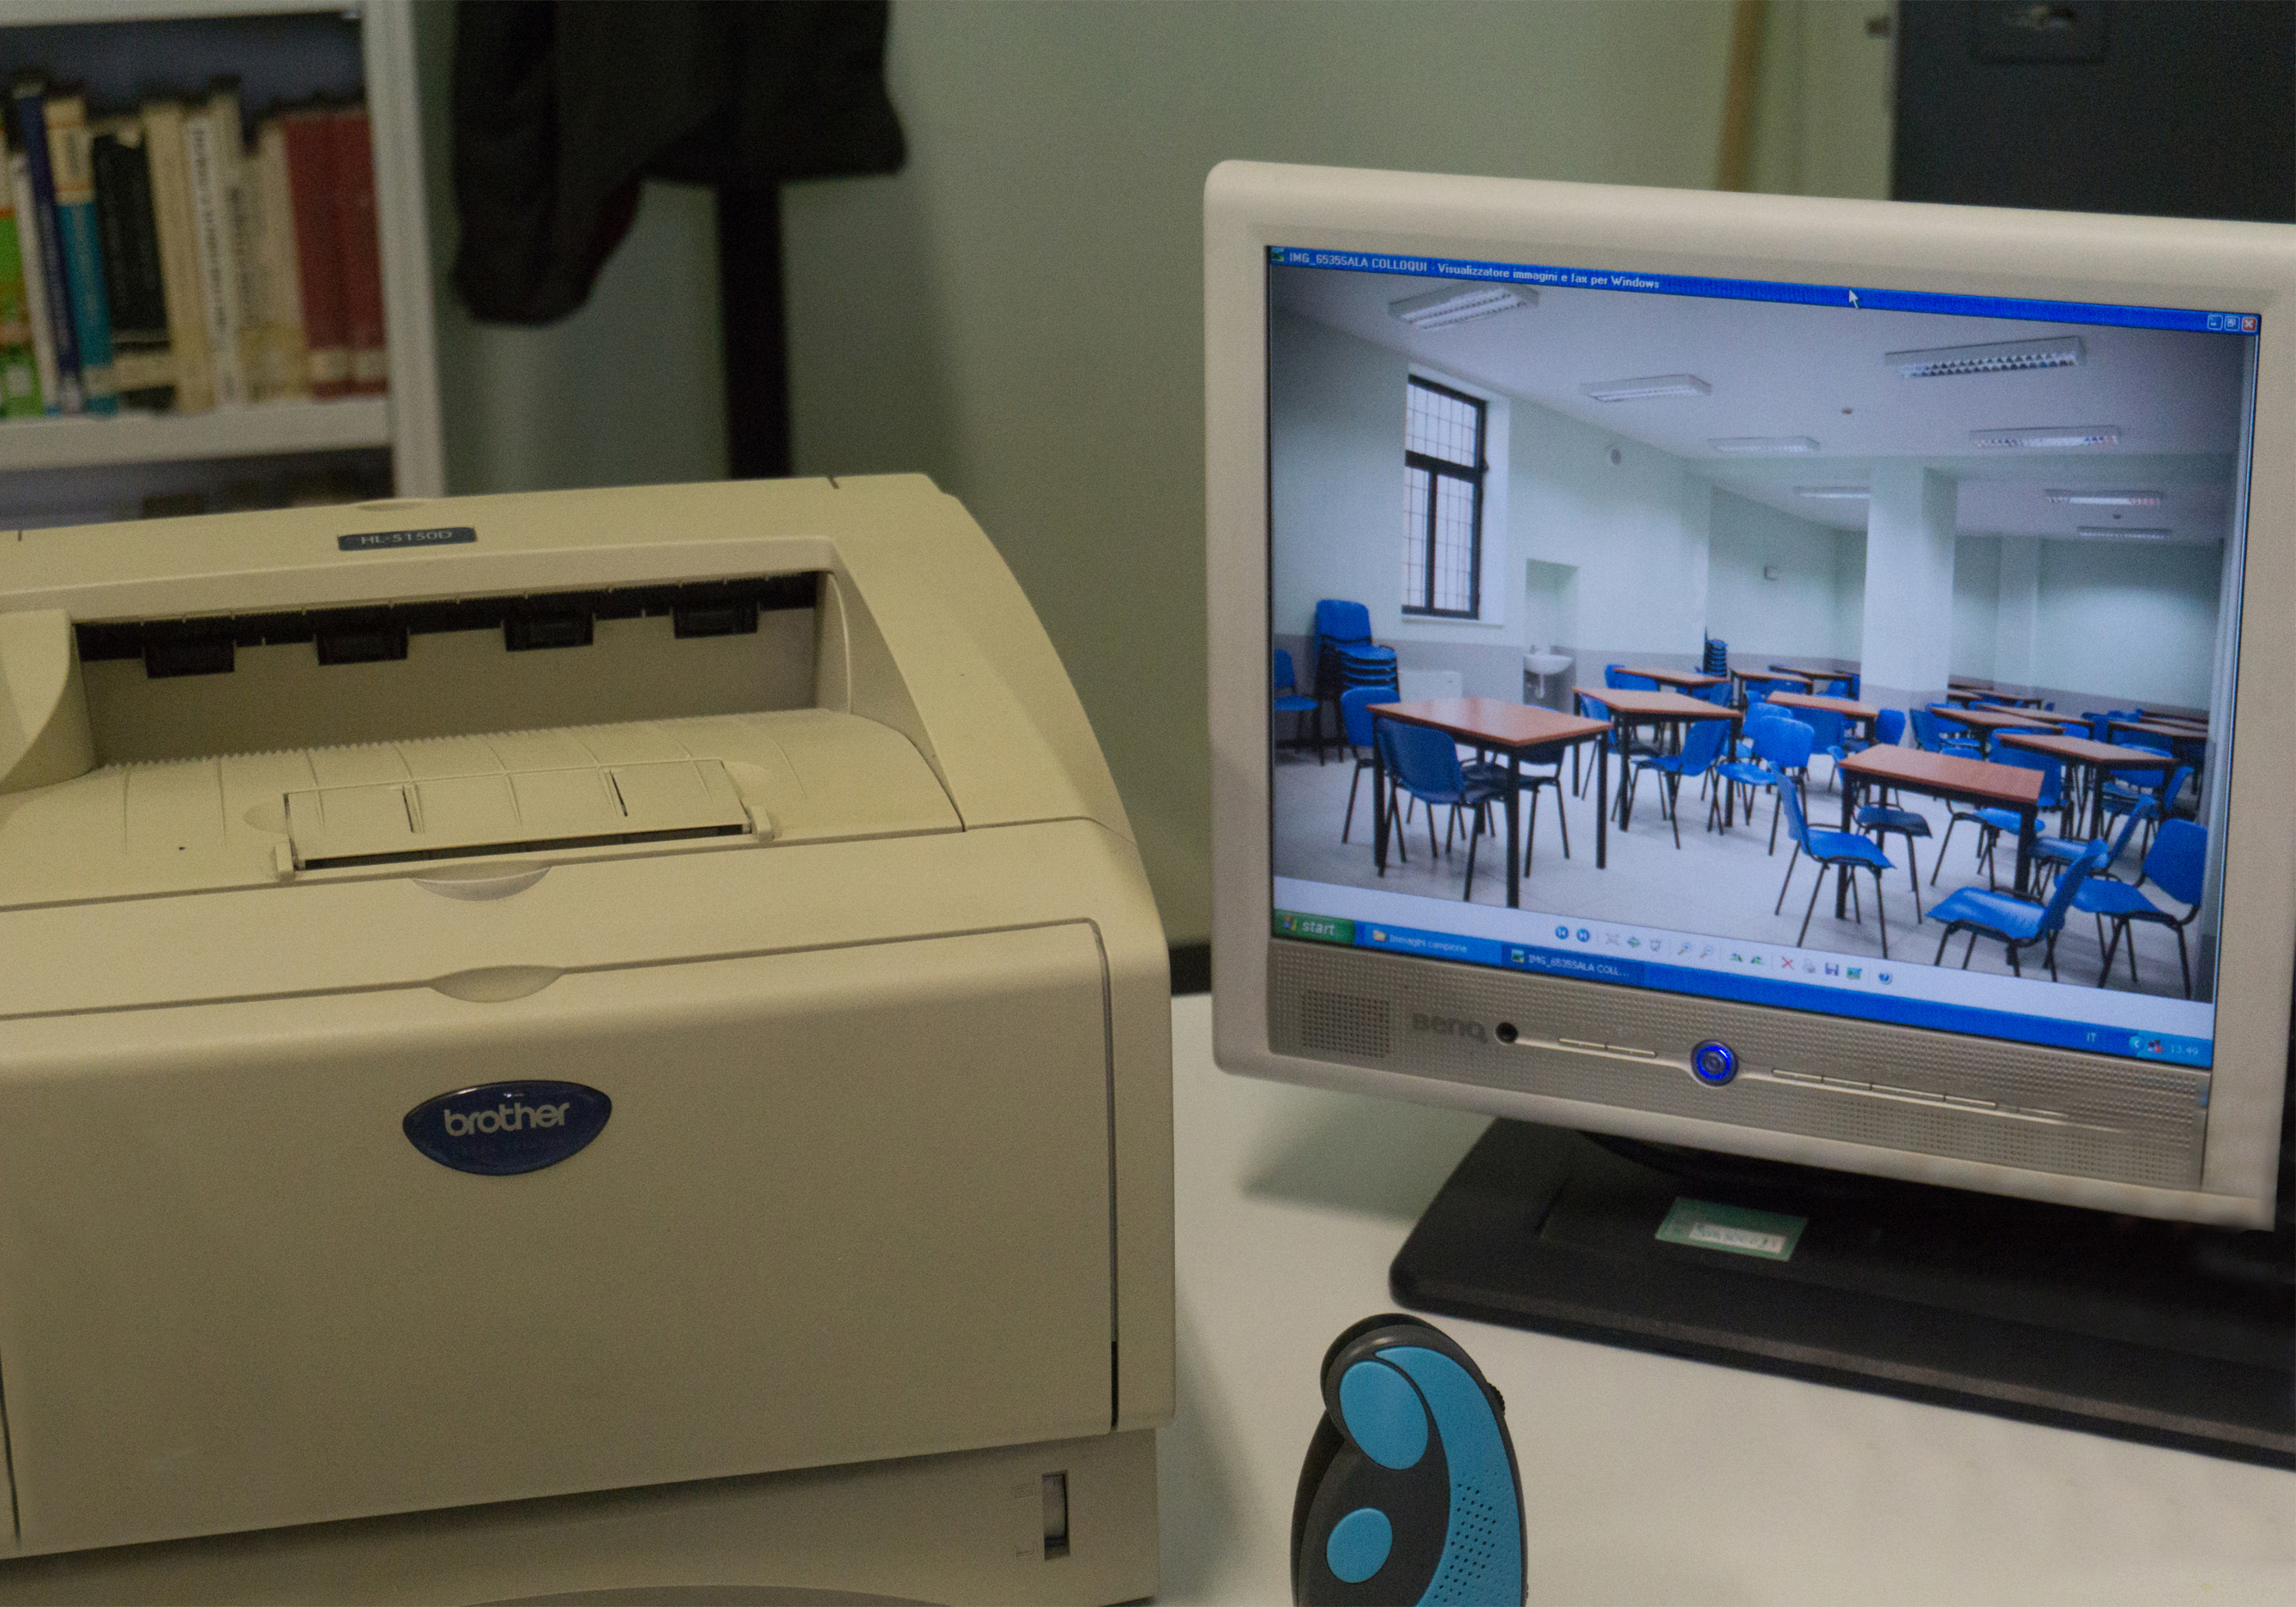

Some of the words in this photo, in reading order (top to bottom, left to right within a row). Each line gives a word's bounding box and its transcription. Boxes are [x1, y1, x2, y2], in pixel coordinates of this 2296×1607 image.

[1289, 252, 1369, 268] IMG_6535SALA
[1371, 257, 1428, 272] COLLOQUI
[1437, 262, 1510, 278] Visualizzatore
[1513, 268, 1558, 283] immagini
[1571, 272, 1588, 284] fax
[1591, 275, 1608, 286] per
[1610, 275, 1660, 289] Windows
[361, 531, 453, 544] HL-5150D
[1302, 920, 1335, 936] start
[444, 1102, 570, 1137] brother
